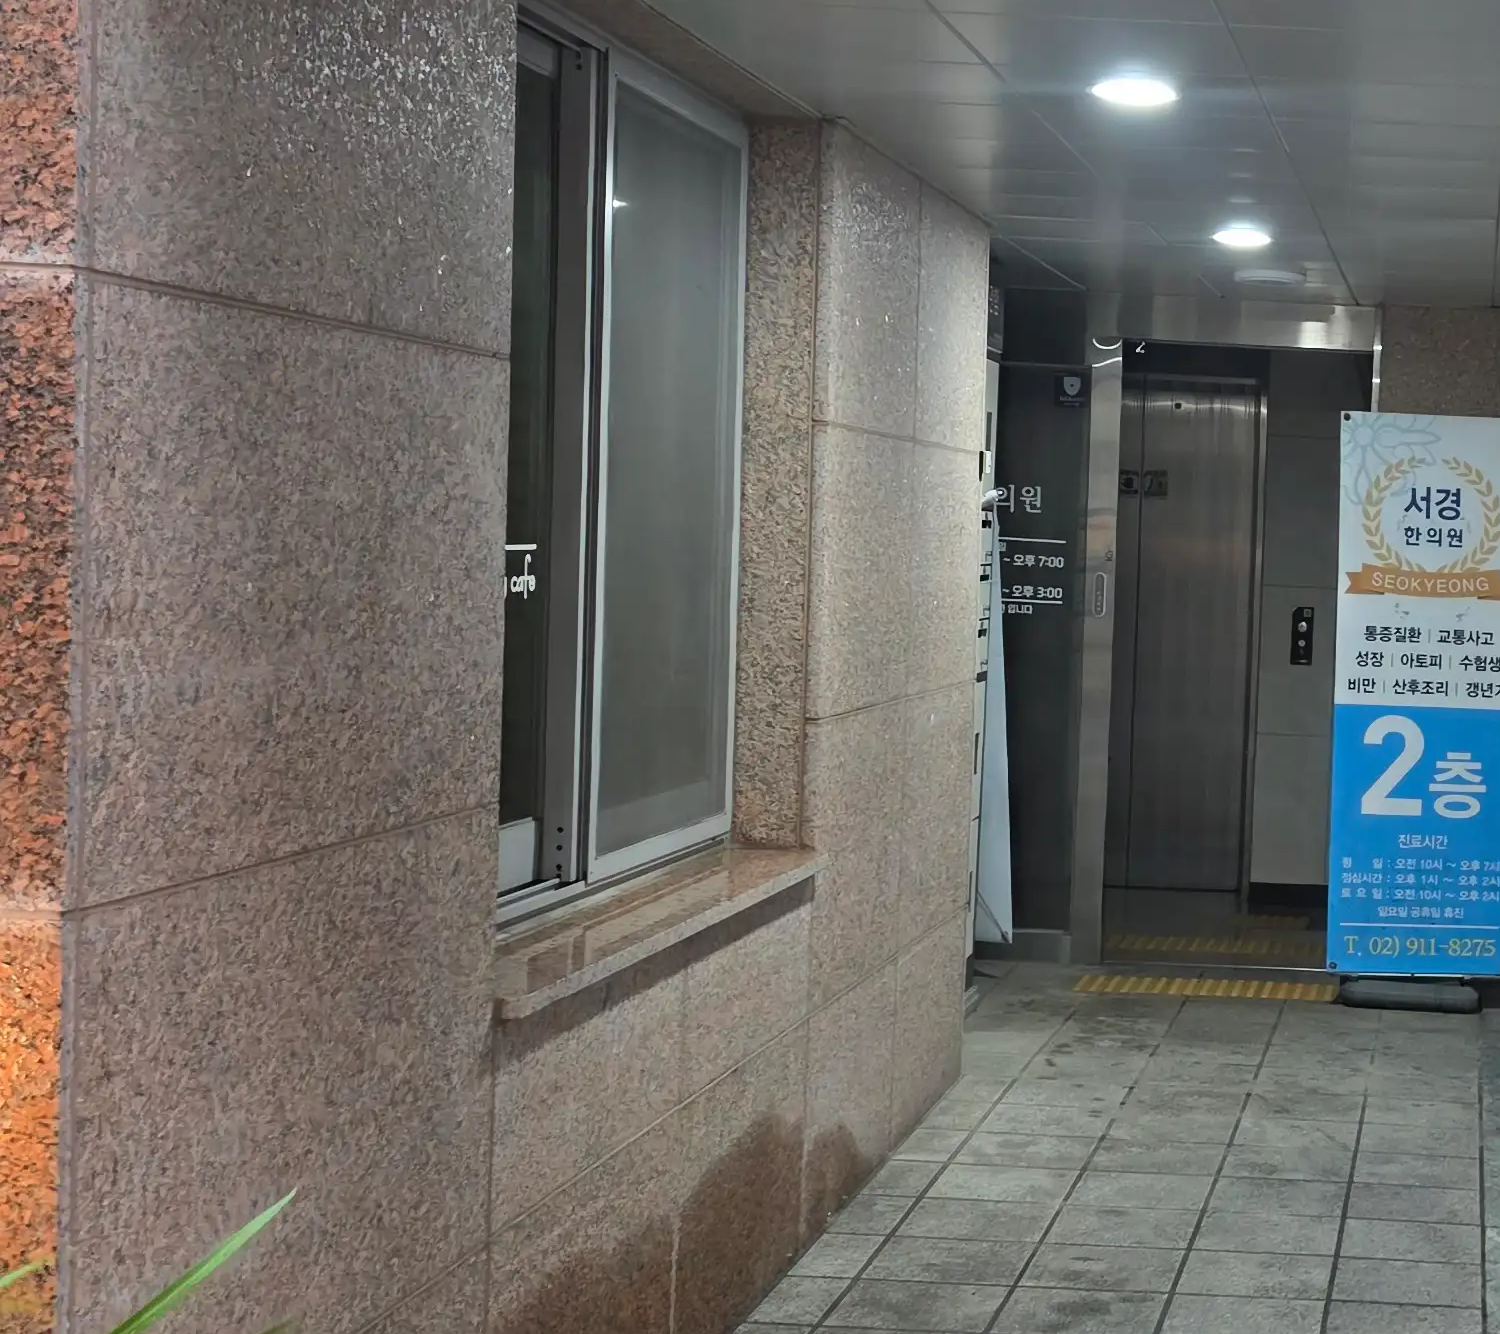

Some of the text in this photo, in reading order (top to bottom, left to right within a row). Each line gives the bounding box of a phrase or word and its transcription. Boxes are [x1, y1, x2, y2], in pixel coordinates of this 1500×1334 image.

[1404, 487, 1462, 520] 서경
[1404, 526, 1464, 548] 한의원
[1013, 554, 1036, 566] 오후
[1038, 556, 1065, 568] 7:00
[510, 553, 536, 600] cafe
[1372, 571, 1490, 593] SEOKYEONG
[1012, 585, 1035, 597] 오후
[1036, 586, 1063, 599] 3:00
[1363, 625, 1495, 646] 통증질환 교통사고
[1355, 651, 1385, 668] 성장
[1400, 653, 1443, 670] 아토피
[1347, 678, 1376, 694] 비만
[1392, 679, 1449, 697] 산후조리
[1361, 714, 1487, 819] 2층
[1398, 834, 1448, 850] 진료시간
[1395, 858, 1416, 870] 오전
[1420, 859, 1443, 871] 10시
[1460, 861, 1480, 871] 오후
[1484, 861, 1500, 872] 7시
[1341, 872, 1383, 885] 점심시간
[1394, 874, 1416, 885] 오후
[1421, 875, 1438, 885] 1시
[1458, 876, 1478, 886] 오후
[1482, 876, 1500, 887] 2시
[1394, 889, 1416, 900] 오전
[1420, 890, 1442, 901] 10시
[1459, 890, 1479, 901] 오후
[1482, 891, 1500, 902] 2시
[1378, 906, 1408, 917] 일요일
[1444, 907, 1465, 919] 휴진
[1369, 937, 1400, 958] 02)
[1406, 938, 1497, 957] 911-8275
